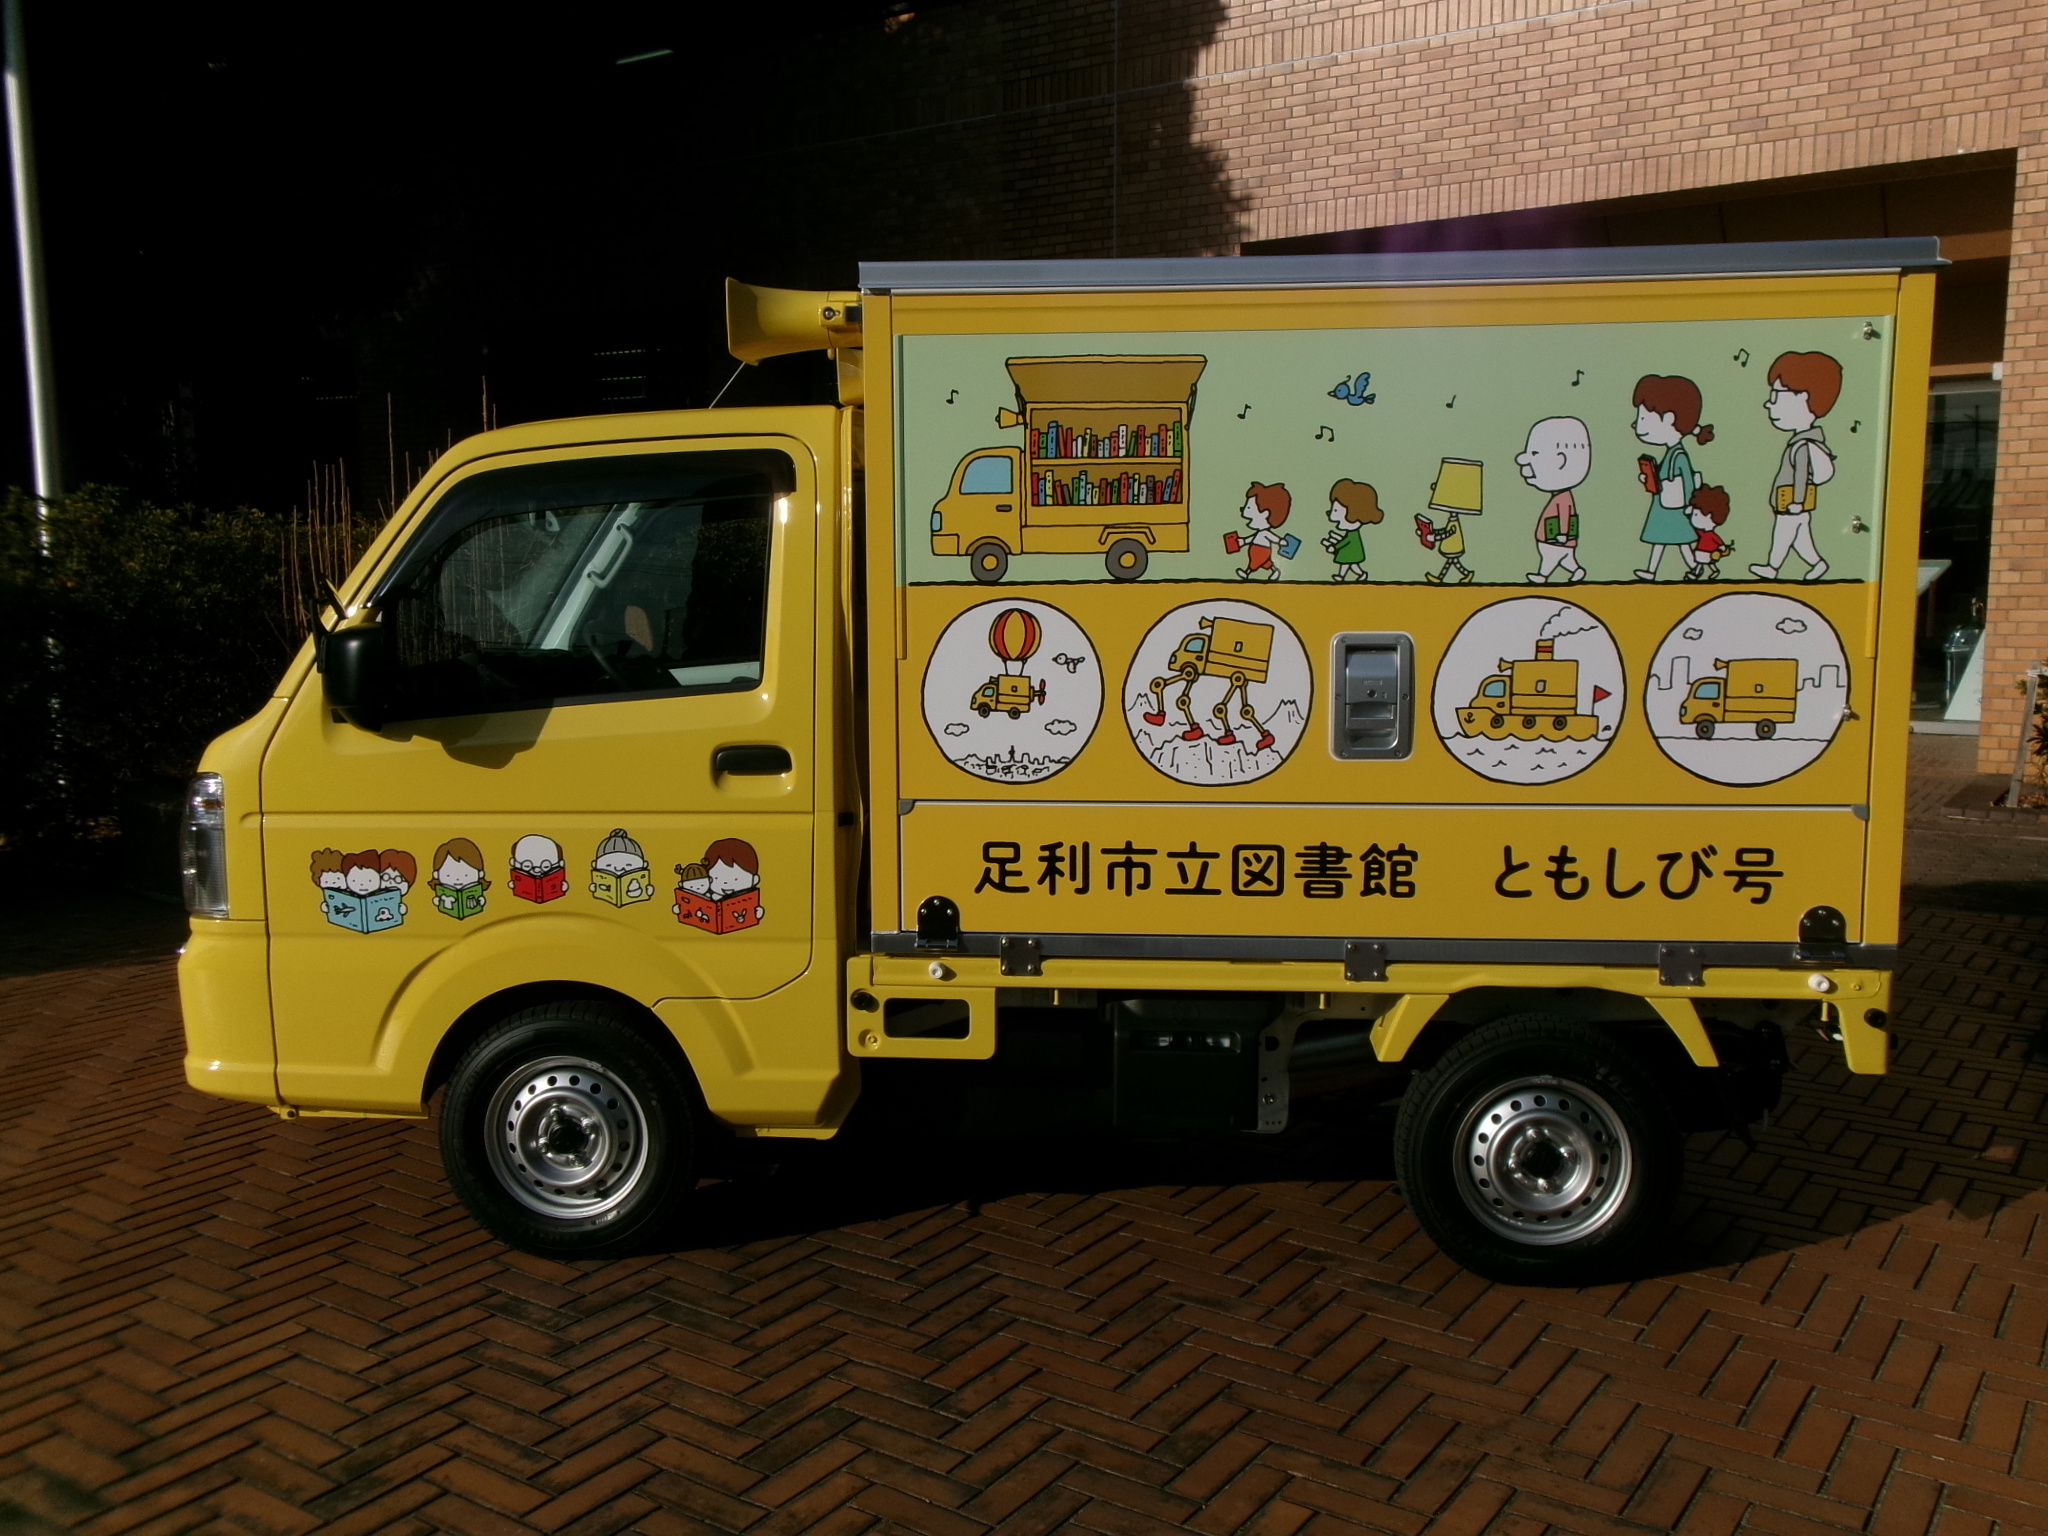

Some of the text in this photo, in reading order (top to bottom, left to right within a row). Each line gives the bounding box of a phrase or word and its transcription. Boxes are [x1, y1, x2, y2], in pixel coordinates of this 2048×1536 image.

[974, 840, 1784, 905] 足利市立図書館 ともしび号
